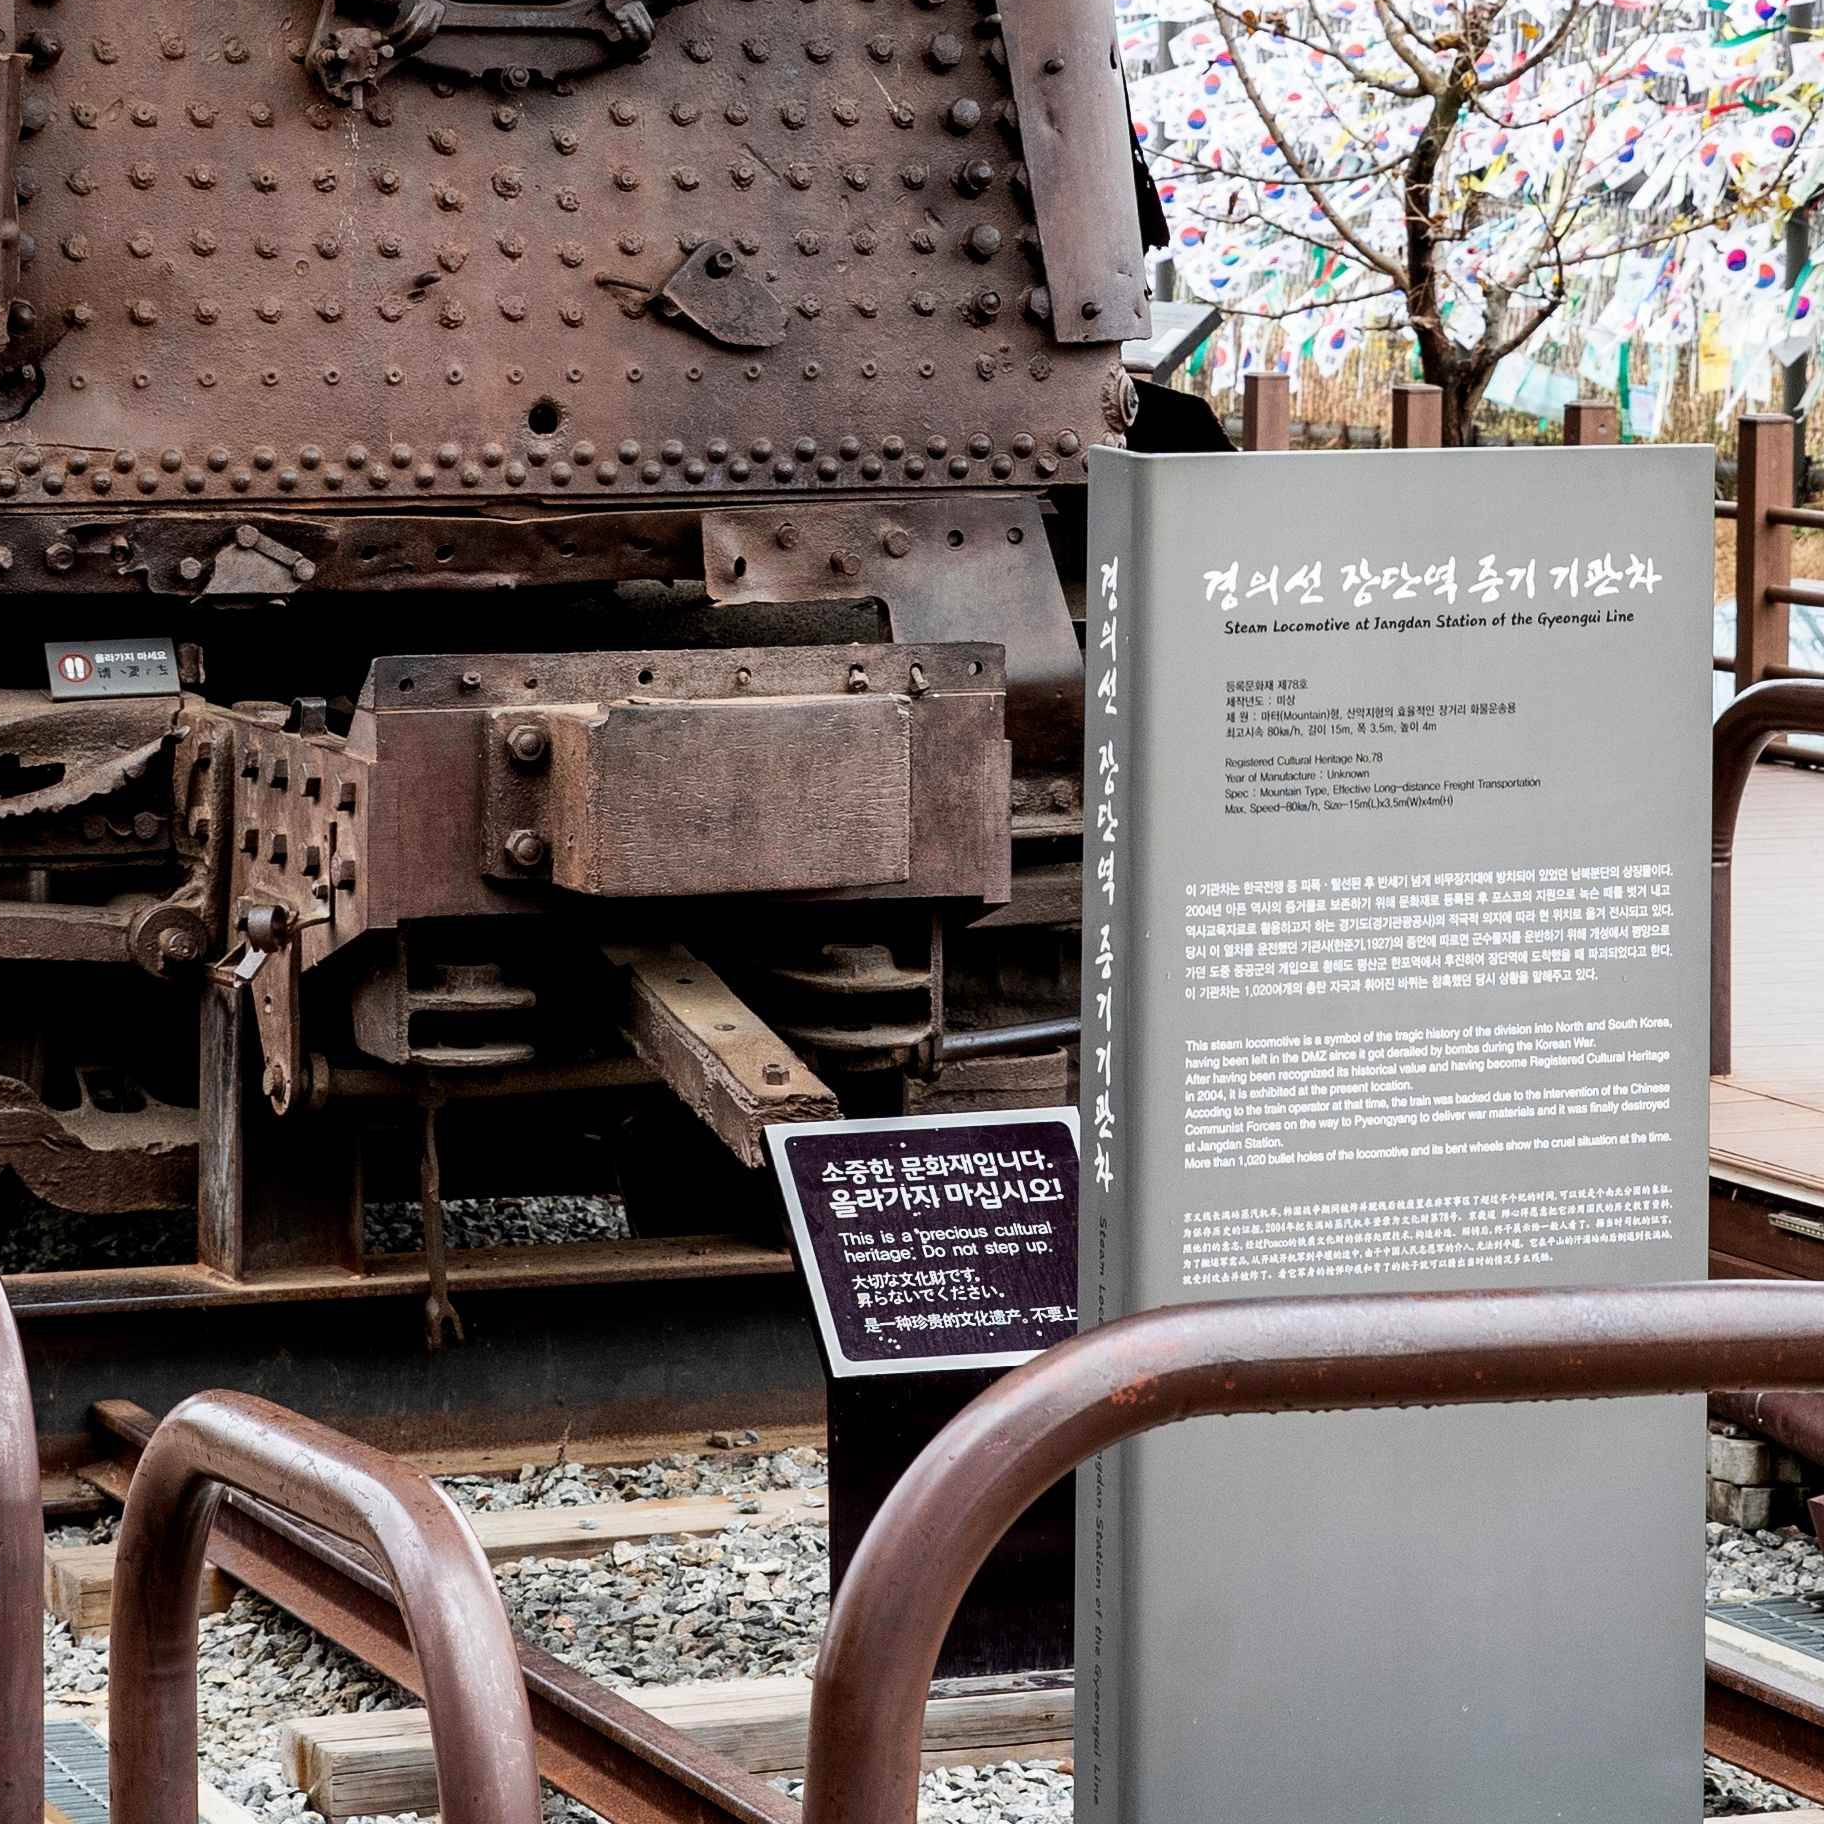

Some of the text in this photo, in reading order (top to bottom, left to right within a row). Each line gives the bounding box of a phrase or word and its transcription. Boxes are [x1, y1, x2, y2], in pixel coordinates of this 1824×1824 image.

[1202, 552, 1664, 611] 경의선 장단역 증기 기관차
[1097, 555, 1119, 715] 경의선
[1223, 608, 1635, 635] Steam Locomotive at Jangdan Station of the Gyeongui Line
[136, 651, 168, 661] 마세요
[1225, 756, 1274, 769] Registered
[1277, 755, 1312, 766] Cultural
[1314, 754, 1353, 765] Heritage
[1225, 769, 1370, 783] Year of Manufacture Unknown
[1096, 739, 1119, 905] 장단역
[1185, 986, 1195, 1000] 이
[1185, 1040, 1208, 1052] This
[1211, 1040, 1243, 1051] steam
[1245, 1035, 1301, 1049] locomotive
[1303, 1034, 1312, 1046] is
[1314, 1036, 1322, 1046] a
[1324, 1032, 1361, 1046] symbol
[1363, 1031, 1374, 1043] of
[1376, 1030, 1393, 1042] the
[1395, 1028, 1424, 1043] tragic
[1425, 1027, 1461, 1041] history
[1462, 1026, 1473, 1038] of
[1475, 1025, 1492, 1037] the
[1494, 1023, 1532, 1036] division
[1534, 1022, 1554, 1034] into
[1555, 1021, 1584, 1033] North
[1586, 1019, 1606, 1031] and
[1608, 1018, 1638, 1030] South
[1185, 1051, 1670, 1085] After having been recognized its historical value and having become Registered Cultural Heritage
[1184, 1132, 1672, 1169] More than 1,020 bullet holes of the locomotive and its bent wheels show the cruel situation at the time.
[1185, 1136, 1284, 1153] at Jangdan Station.
[821, 1149, 1054, 1185] 소중한 문화재입니다.
[828, 1178, 1065, 1219] 올라가지 마십시오!
[838, 1221, 1053, 1246] This is a precious cultural
[1098, 1215, 1108, 1276] Steam
[921, 1245, 946, 1258] Do
[952, 1242, 979, 1256] not
[984, 1241, 1020, 1256] step
[1025, 1240, 1054, 1255] up.
[851, 1267, 981, 1291] 大切な文化財です。
